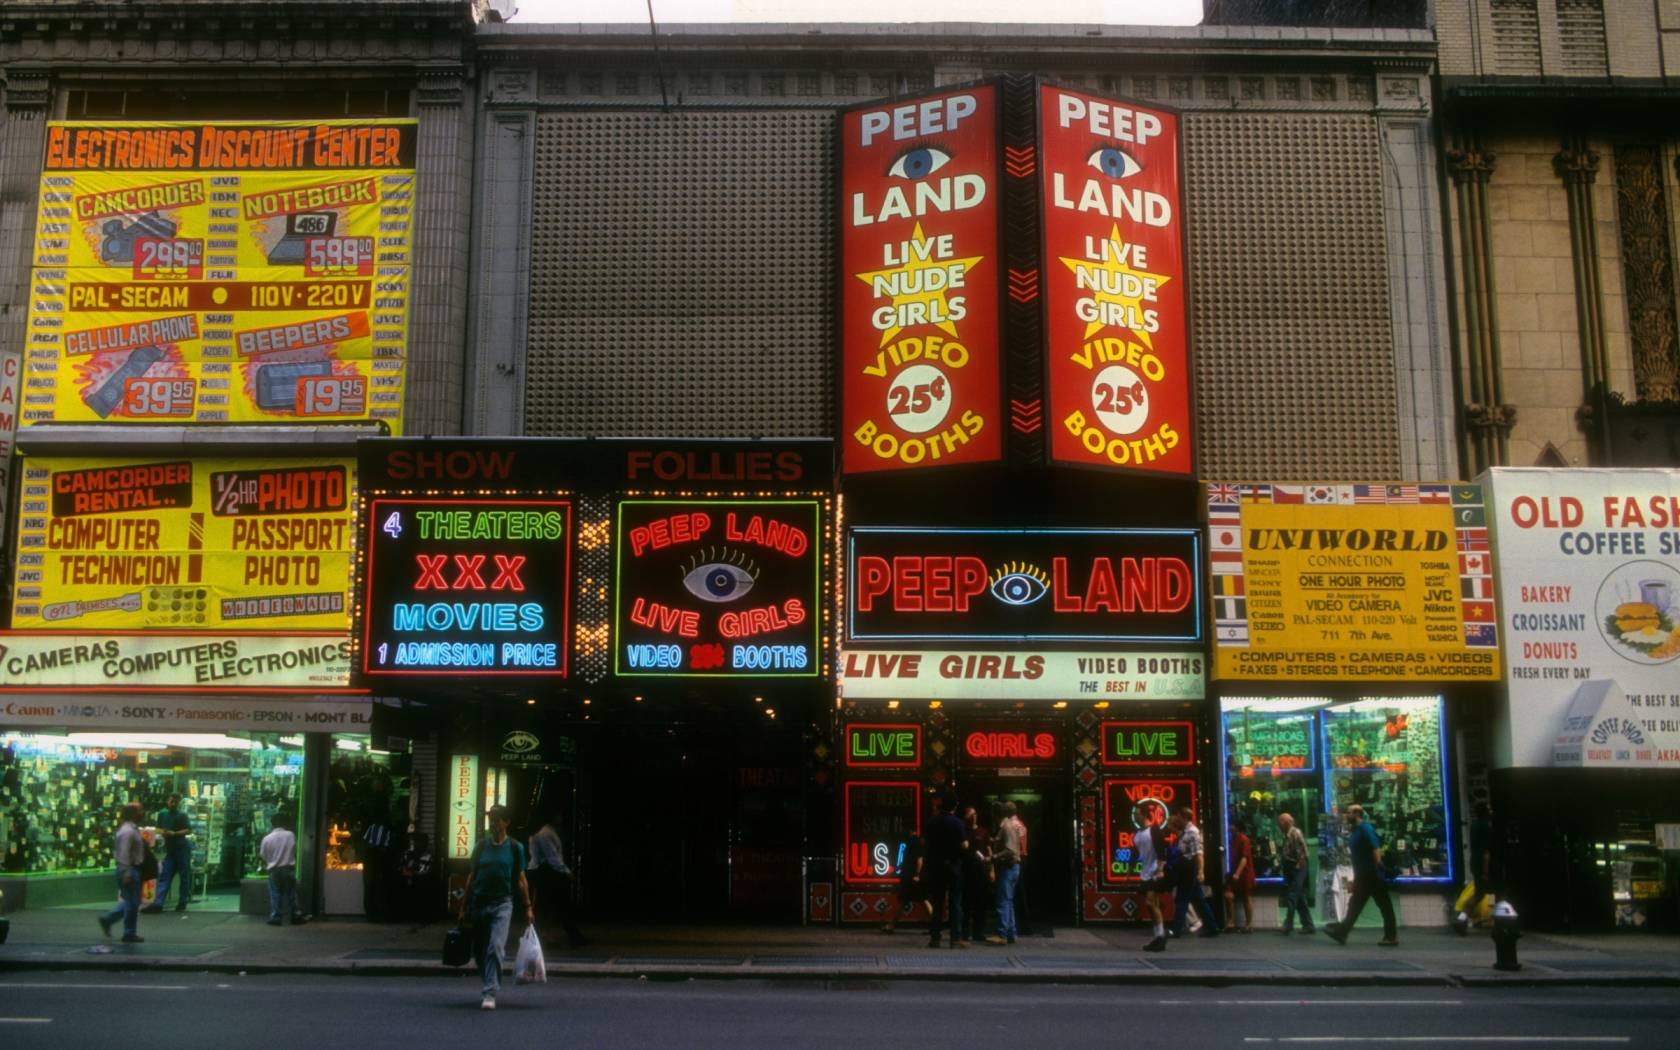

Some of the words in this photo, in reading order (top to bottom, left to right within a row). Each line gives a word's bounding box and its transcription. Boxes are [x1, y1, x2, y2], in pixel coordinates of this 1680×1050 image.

[861, 95, 977, 147] PEEP
[1058, 94, 1162, 145] PEEP
[47, 127, 196, 168] ELECTRONICS
[201, 127, 308, 168] DISCOUNT
[315, 126, 401, 167] CENTER
[213, 177, 239, 186] JVC
[79, 181, 204, 218] CAMCORDER
[212, 192, 237, 201] IBM
[244, 181, 372, 217] NOTEBOOK
[853, 174, 986, 227] LAND
[1053, 173, 1172, 227] LAND
[211, 208, 229, 217] NEC
[297, 216, 325, 232] 486
[883, 235, 953, 266] LIVE
[1085, 236, 1148, 268] LIVE
[211, 271, 233, 279] FUJI
[377, 282, 403, 292] SONY
[872, 264, 965, 298] NUDE
[1076, 265, 1158, 303] NUDE
[72, 286, 188, 307] PAL-SECAM
[33, 318, 62, 327] Canon
[375, 315, 400, 324] JVC
[872, 297, 967, 330] GIRLS
[1075, 298, 1160, 333] GIRLS
[32, 334, 59, 342] RCA
[66, 325, 150, 354] CELLULAR
[152, 316, 197, 343] PHONE
[239, 317, 350, 354] BEEPERS
[862, 336, 970, 379] VIDEO
[1070, 337, 1165, 382] VIDEO
[889, 375, 945, 415] 25¢
[1095, 380, 1145, 415] 25¢
[198, 411, 223, 420] APPLE
[854, 410, 985, 464] BOOTHS
[1064, 410, 1179, 465] BOOTHS
[387, 452, 516, 479] SHOW
[628, 451, 803, 480] FOLLIES
[56, 465, 191, 494] CAMCORDER
[258, 472, 344, 512] PHOTO
[384, 512, 402, 538] 4
[416, 511, 562, 540] THEATERS
[1511, 496, 1584, 529] OLD
[48, 518, 161, 550] COMPUTER
[232, 518, 348, 550] PASSPORT
[630, 513, 711, 557] PEEP
[727, 513, 808, 557] LAND
[1248, 529, 1449, 551] UNIWORLD
[1560, 532, 1646, 555] COFFEE
[60, 556, 181, 585] TECHNICION
[244, 556, 320, 586] PHOTO
[1308, 555, 1393, 567] CONNECTION
[1420, 562, 1450, 570] TOSHIBA
[20, 572, 40, 581] JVC
[857, 557, 988, 612] PEEP
[1053, 557, 1192, 612] LAND
[1299, 576, 1324, 586] ONE
[1329, 576, 1361, 586] HOUR
[1367, 576, 1406, 586] PHOTO
[1306, 600, 1343, 611] VIDEO
[1349, 600, 1401, 611] CAMERA
[1423, 590, 1453, 601] JVC
[1521, 586, 1571, 603] BAKERY
[393, 603, 545, 632] MOVIES
[632, 598, 699, 637] LIVE
[719, 598, 806, 638] GIRLS
[1252, 611, 1284, 619] Canon
[1293, 615, 1353, 625] PAL-SECAM
[1424, 604, 1455, 612] Nikon
[1253, 622, 1285, 631] SEIKO
[1349, 630, 1366, 640] 7th
[1372, 630, 1393, 640] Ave.
[1512, 614, 1585, 632] CROISSANT
[7, 640, 120, 675] CAMERAS
[102, 640, 238, 678] COMPUTERS
[195, 641, 352, 683] ELECTRONICS
[378, 645, 388, 665] 1
[395, 643, 494, 667] ADMISSION
[502, 643, 556, 667] PRICE
[627, 644, 682, 668] VIDEO
[732, 645, 808, 669] BOOTHS
[1239, 652, 1336, 663] COMPUTERS
[1349, 652, 1427, 663] CAMERAS
[1436, 653, 1493, 663] VIDEOS
[1523, 642, 1577, 660] DONUTS
[844, 655, 922, 679] LIVE
[939, 655, 1045, 679] GIRLS
[1078, 658, 1127, 674] VIDEO
[1137, 658, 1202, 675] BOOTHS
[1240, 665, 1278, 675] FAXES
[1286, 665, 1338, 675] STEREOS
[1341, 665, 1406, 675] TELEPHONE
[1415, 665, 1493, 676] CAMCORDERS
[1512, 667, 1539, 679] FRESH
[1543, 668, 1570, 679] EVERY
[1573, 668, 1591, 680] DAY
[1080, 681, 1098, 692] THE
[1106, 681, 1130, 692] BEST
[1135, 681, 1147, 692] IN
[5, 702, 55, 716] Canon
[63, 705, 112, 717] MINOLTA
[121, 706, 166, 719] SONY
[176, 708, 244, 721] Panasonic
[253, 711, 293, 722] EPSON
[305, 712, 347, 723] MONT
[1645, 694, 1666, 707] BEST
[1116, 732, 1178, 756] LIVE
[1591, 717, 1619, 745] COFFEE
[1620, 719, 1645, 745] SHOP
[852, 733, 914, 757] LIVE
[966, 732, 1056, 759] GIRLS
[460, 757, 470, 798] PEEP
[1124, 784, 1175, 802] VIDEO
[456, 815, 469, 857] LAND
